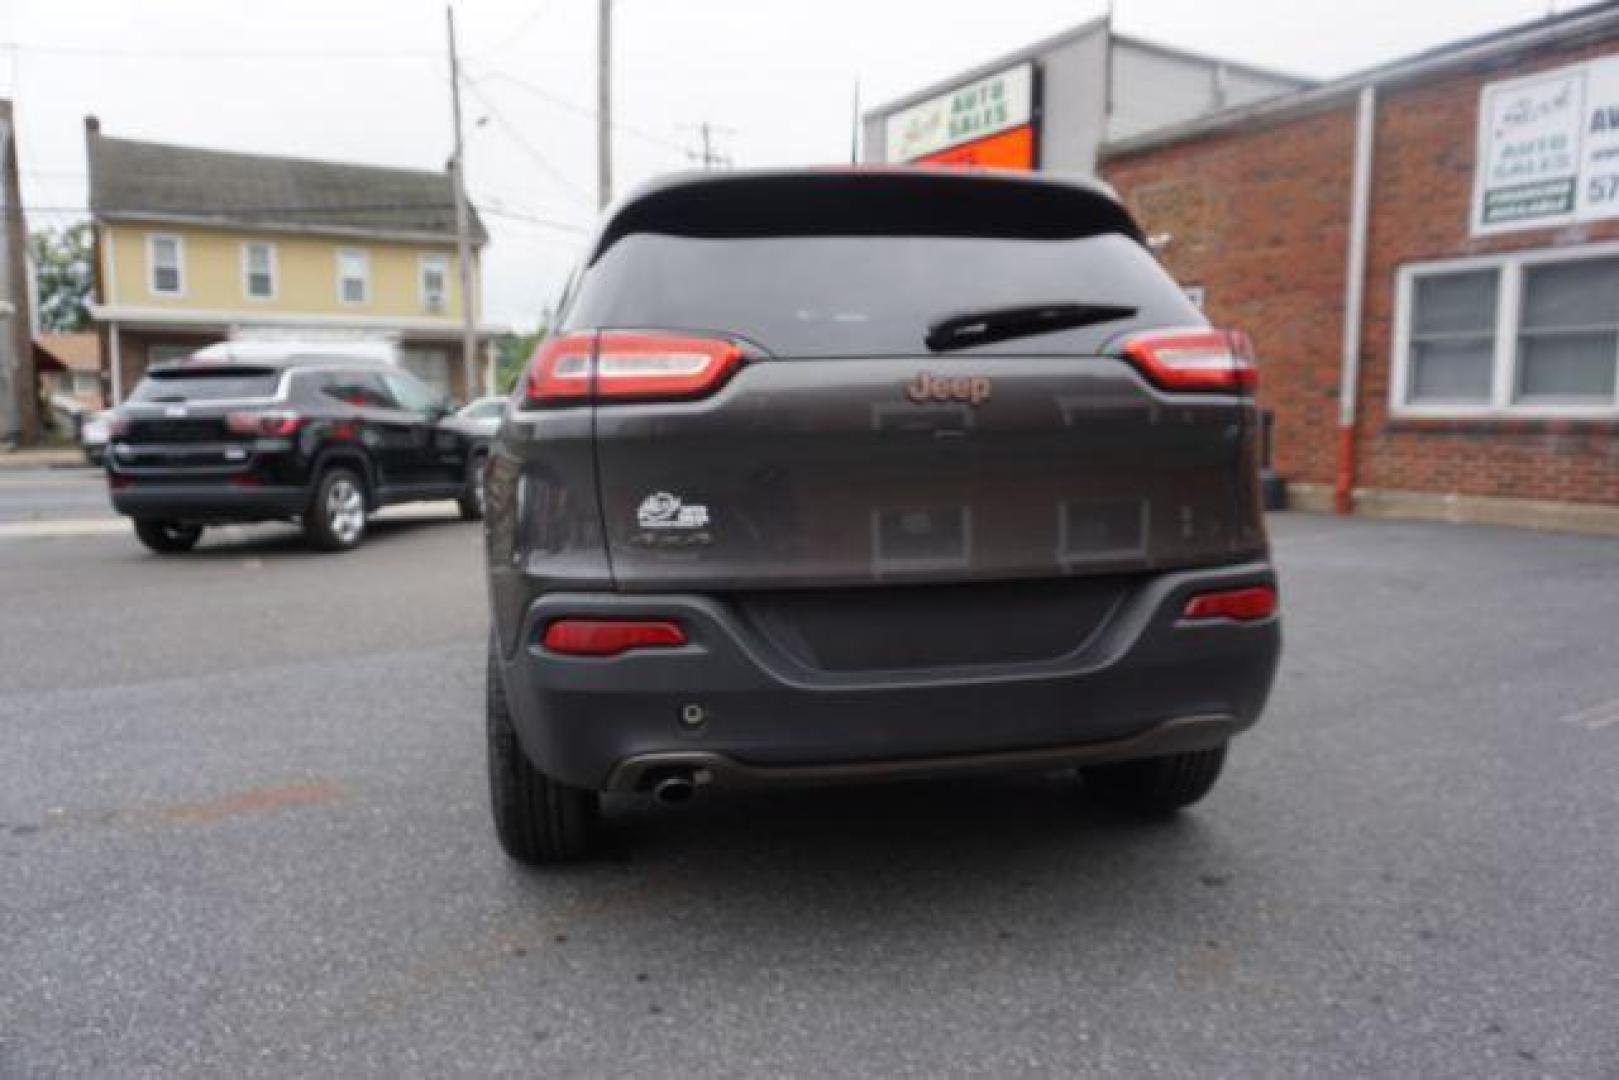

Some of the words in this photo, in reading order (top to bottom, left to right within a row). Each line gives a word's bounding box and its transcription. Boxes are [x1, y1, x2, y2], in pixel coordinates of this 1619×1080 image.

[950, 79, 1004, 115] AUTO
[948, 101, 1007, 138] SALES
[1502, 133, 1569, 157] AUTO
[1494, 154, 1571, 178] SALES
[907, 371, 992, 405] Jeep
